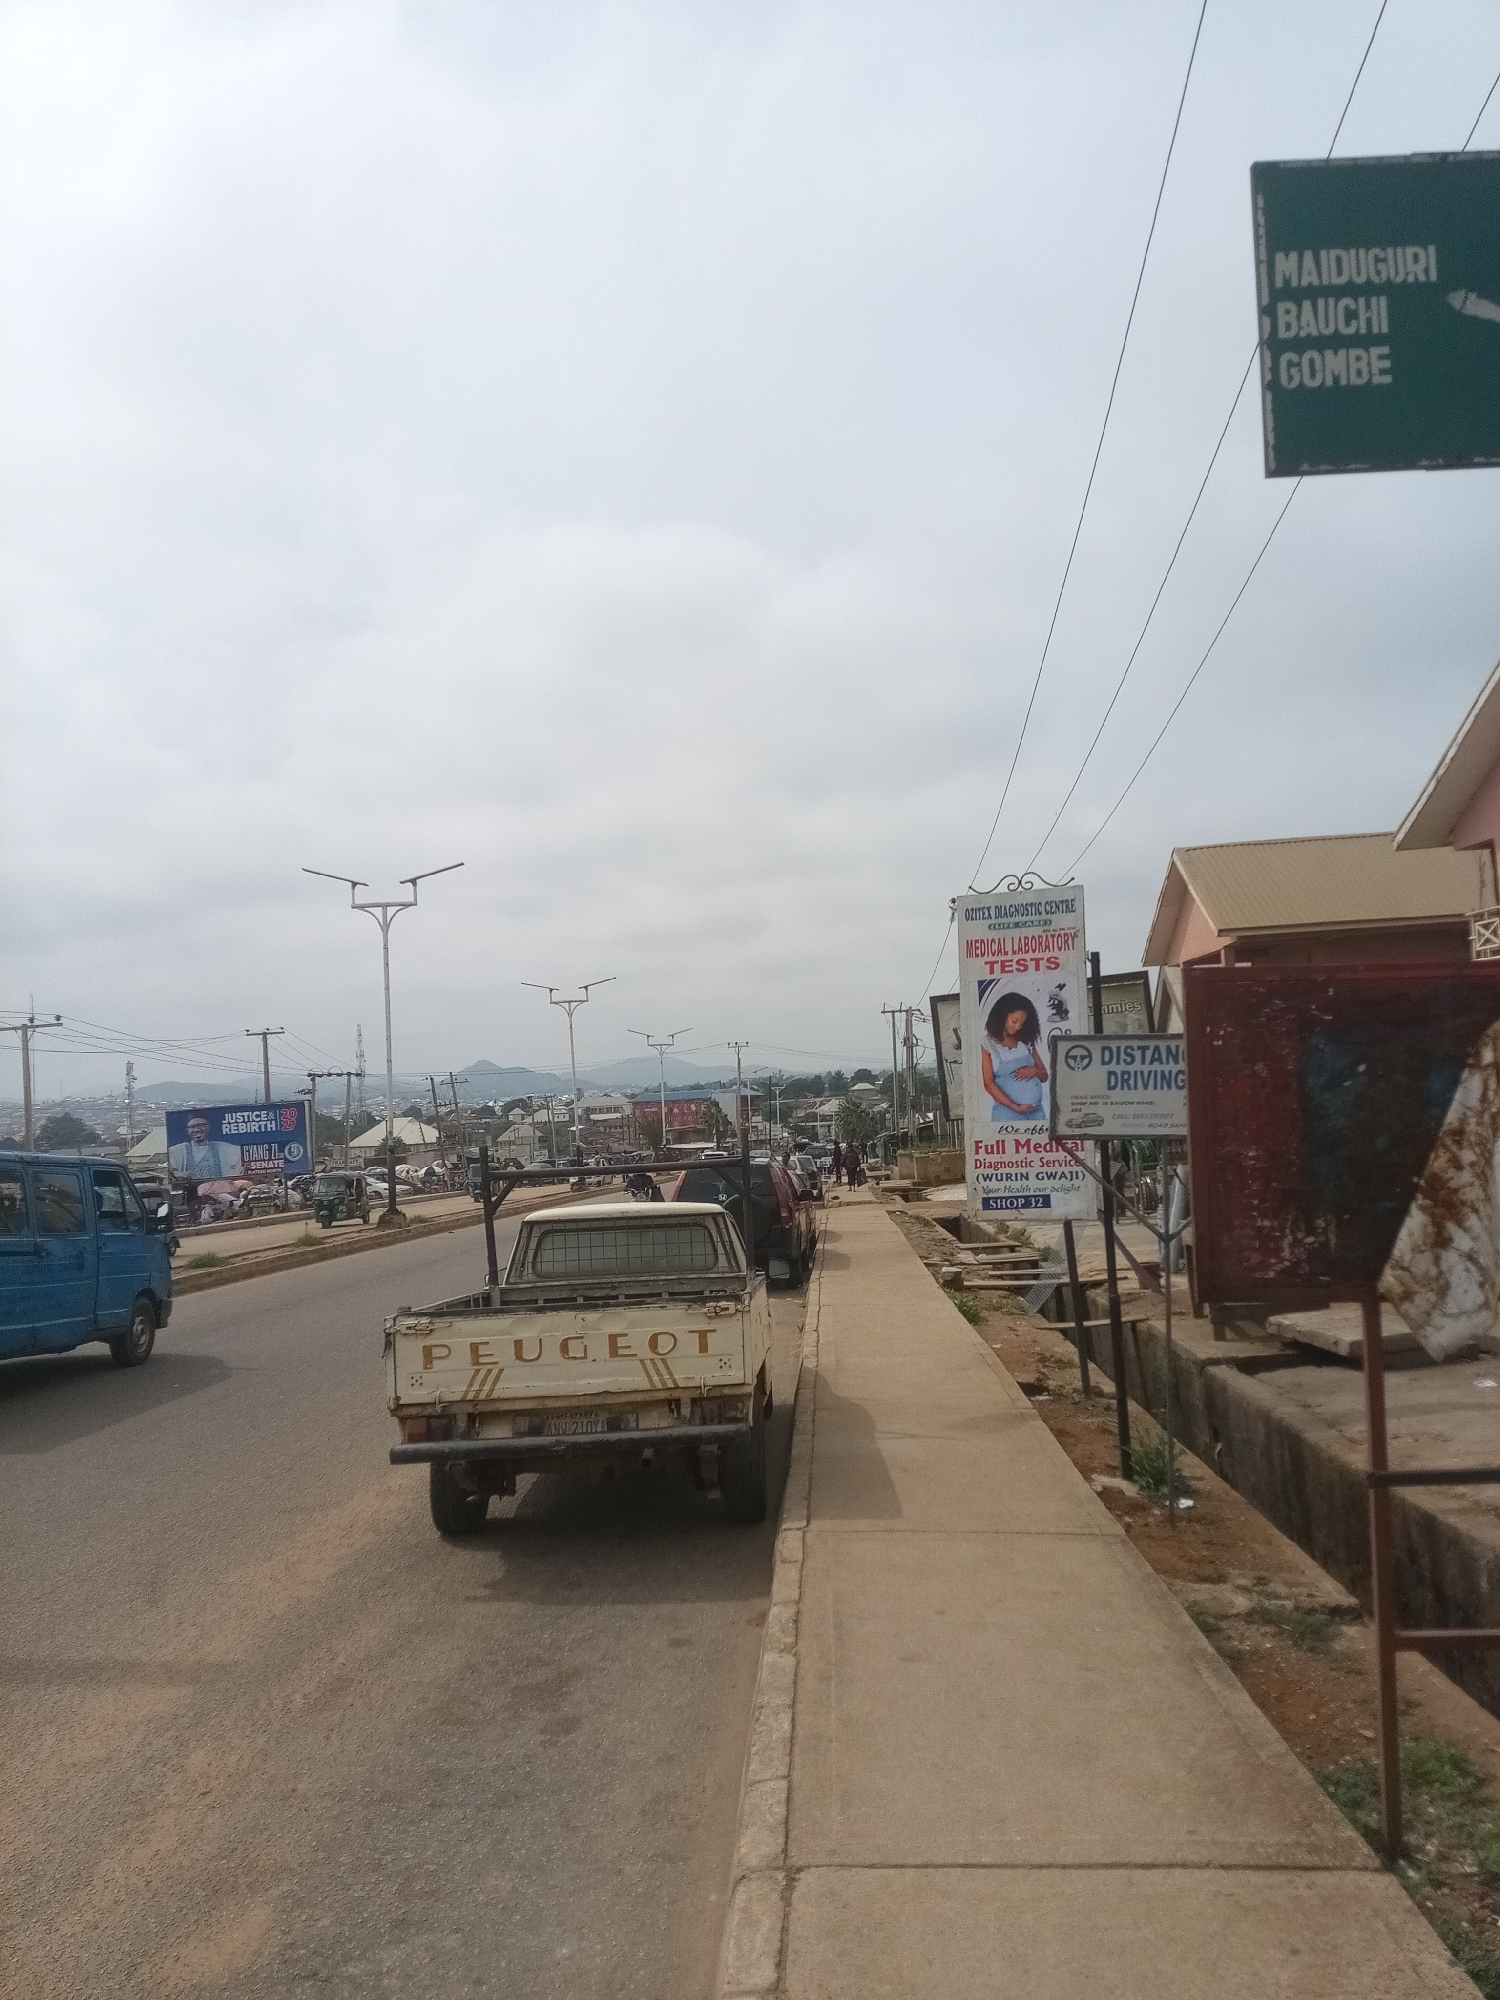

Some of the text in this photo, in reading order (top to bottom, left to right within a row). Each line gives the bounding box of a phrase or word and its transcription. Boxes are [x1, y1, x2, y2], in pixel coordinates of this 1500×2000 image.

[1274, 244, 1437, 288] MAIDUGURI
[1276, 295, 1389, 339] BAUCHI
[1279, 345, 1392, 389] GOMBE
[965, 898, 1077, 922] OZITEX DIAGNOSTIC CENTRE
[966, 932, 1077, 958] MEDICAL LABORATORY
[984, 956, 1061, 975] TESTS
[1107, 1069, 1186, 1091] DRIVING
[222, 1110, 267, 1123] JUSTICE
[281, 1108, 297, 1120] 20
[222, 1120, 276, 1135] REBIRTH
[281, 1120, 296, 1131] 27
[997, 1124, 1020, 1134] We
[243, 1143, 269, 1161] GYANG
[974, 1139, 1006, 1155] Full
[250, 1160, 284, 1169] SENATE
[974, 1157, 1035, 1172] Diagnostic
[976, 1170, 1085, 1184] (WURIN GWAJI)
[1001, 1184, 1031, 1194] Health
[989, 1197, 1044, 1209] SHOP 32
[421, 1328, 717, 1371] PEUGEOT
